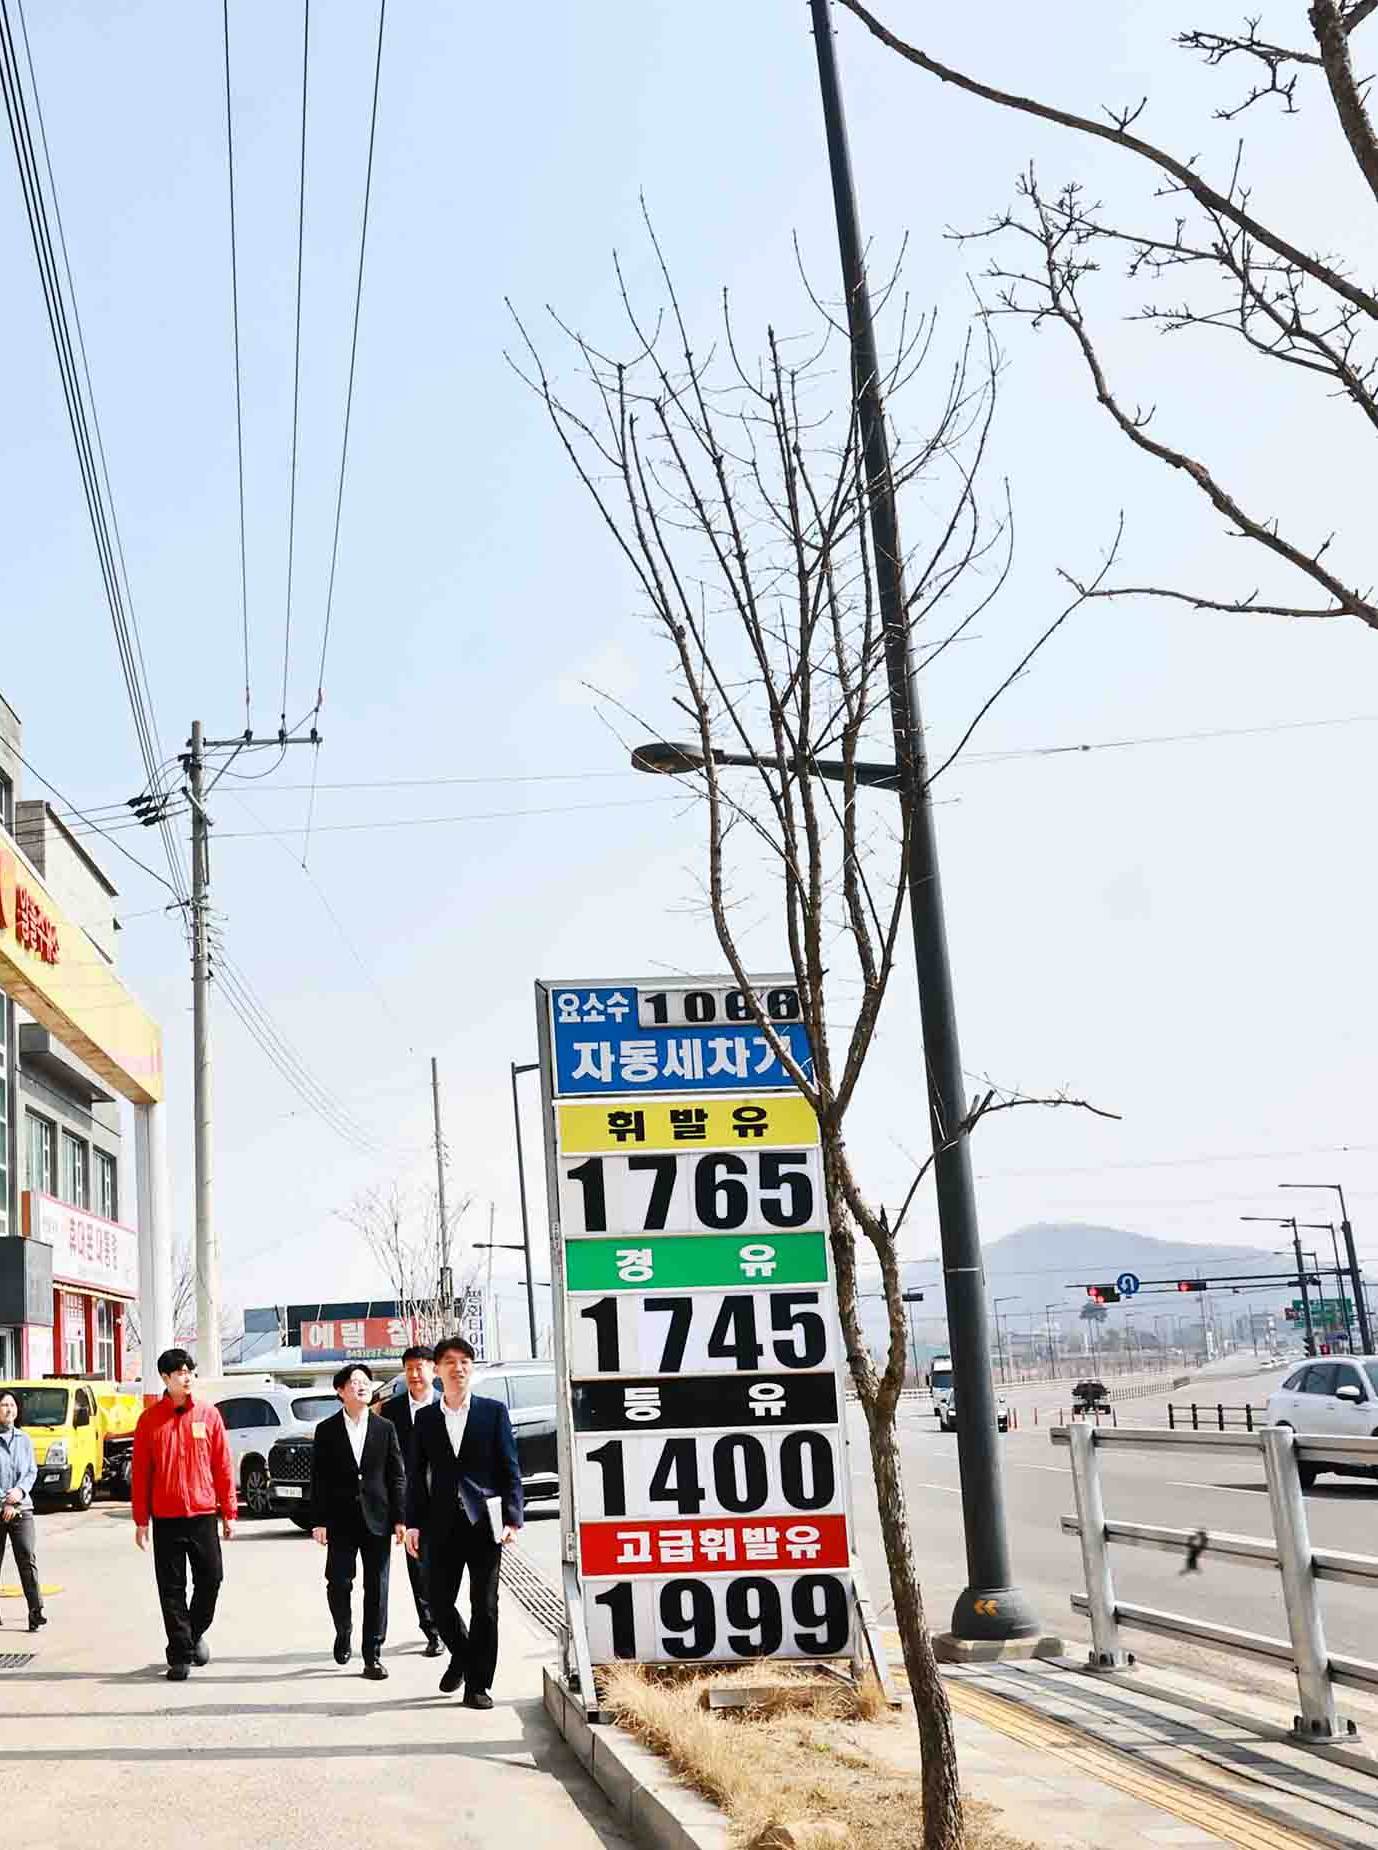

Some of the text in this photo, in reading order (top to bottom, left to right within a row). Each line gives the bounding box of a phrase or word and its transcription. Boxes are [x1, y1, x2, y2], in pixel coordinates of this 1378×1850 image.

[557, 991, 630, 1024] 요소수
[607, 1106, 769, 1142] 휘발유
[567, 1152, 814, 1232] 1765
[615, 1244, 777, 1282] 경유
[581, 1292, 827, 1372] 1745
[623, 1382, 786, 1421] 등유
[586, 1430, 835, 1516] 1400
[616, 1525, 821, 1564] 고급휘발유
[595, 1574, 849, 1660] 1999
